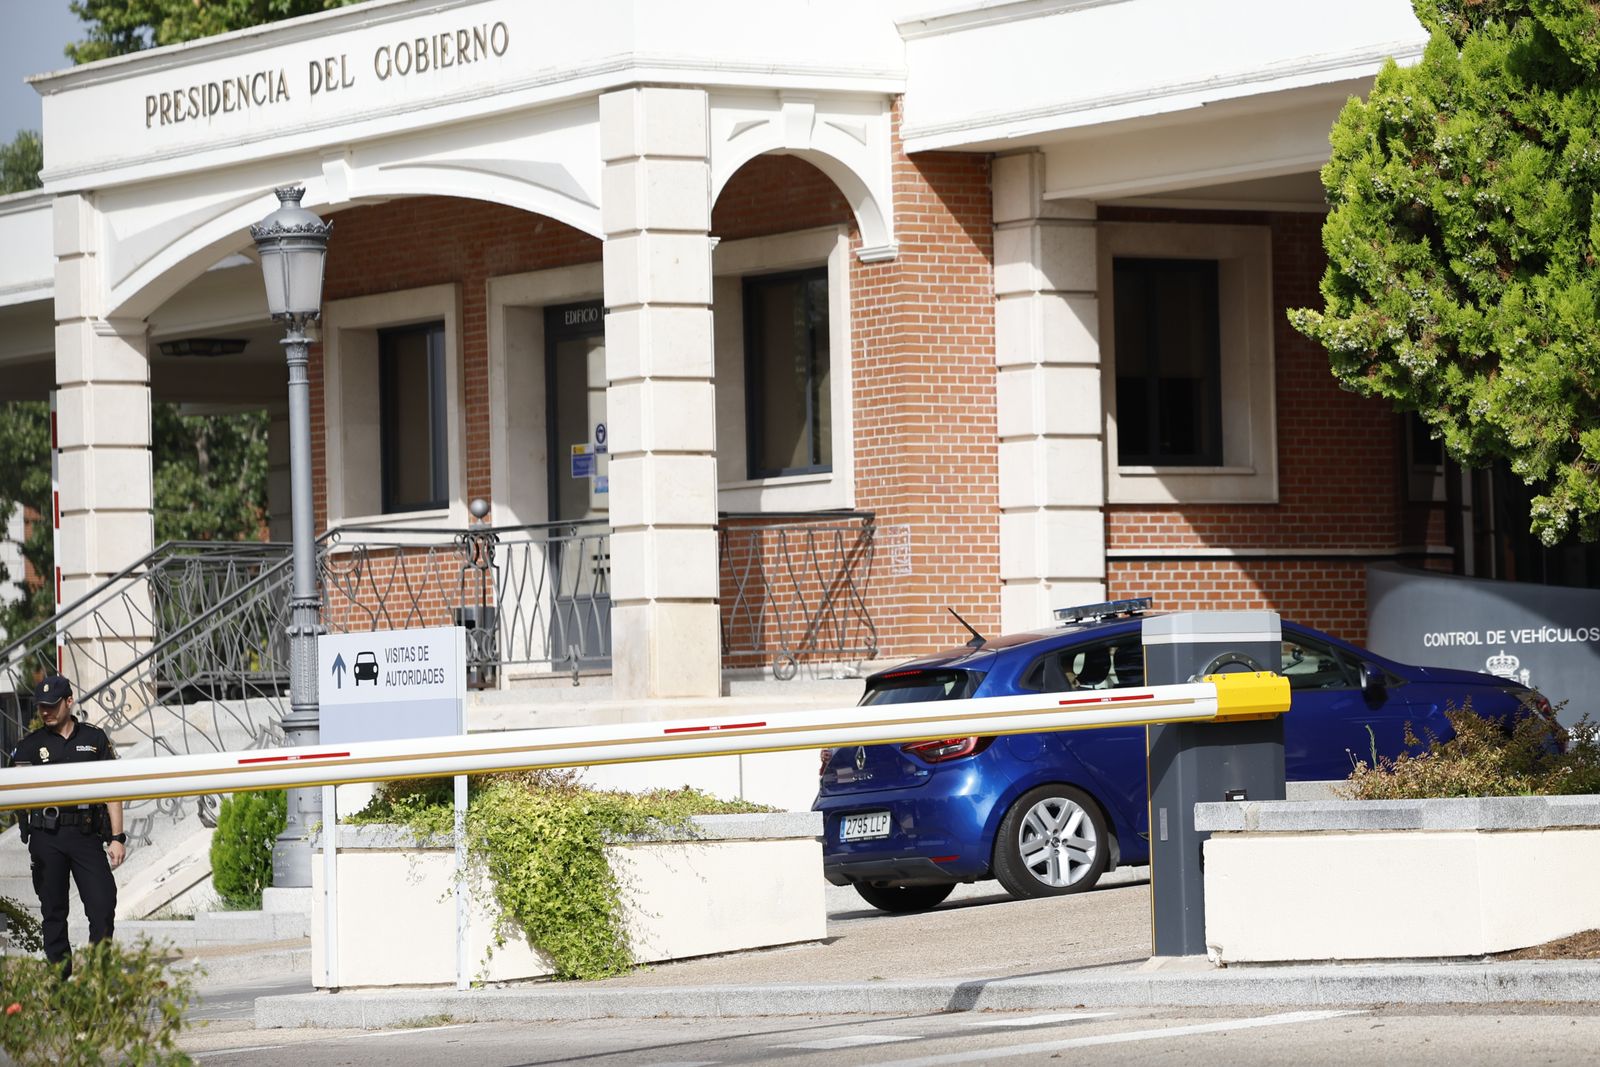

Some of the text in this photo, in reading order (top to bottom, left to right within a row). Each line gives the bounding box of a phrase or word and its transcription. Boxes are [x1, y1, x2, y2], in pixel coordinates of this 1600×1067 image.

[145, 21, 509, 128] PRESIDENCIA DEL GOBIERNO
[565, 306, 598, 325] EDIFICIO
[1424, 625, 1600, 647] CONTROL DE VEHÍCULOS
[385, 645, 429, 663] VISITAS DE
[385, 668, 444, 687] AUTORIDADES
[846, 815, 888, 835] 2795 LLP
